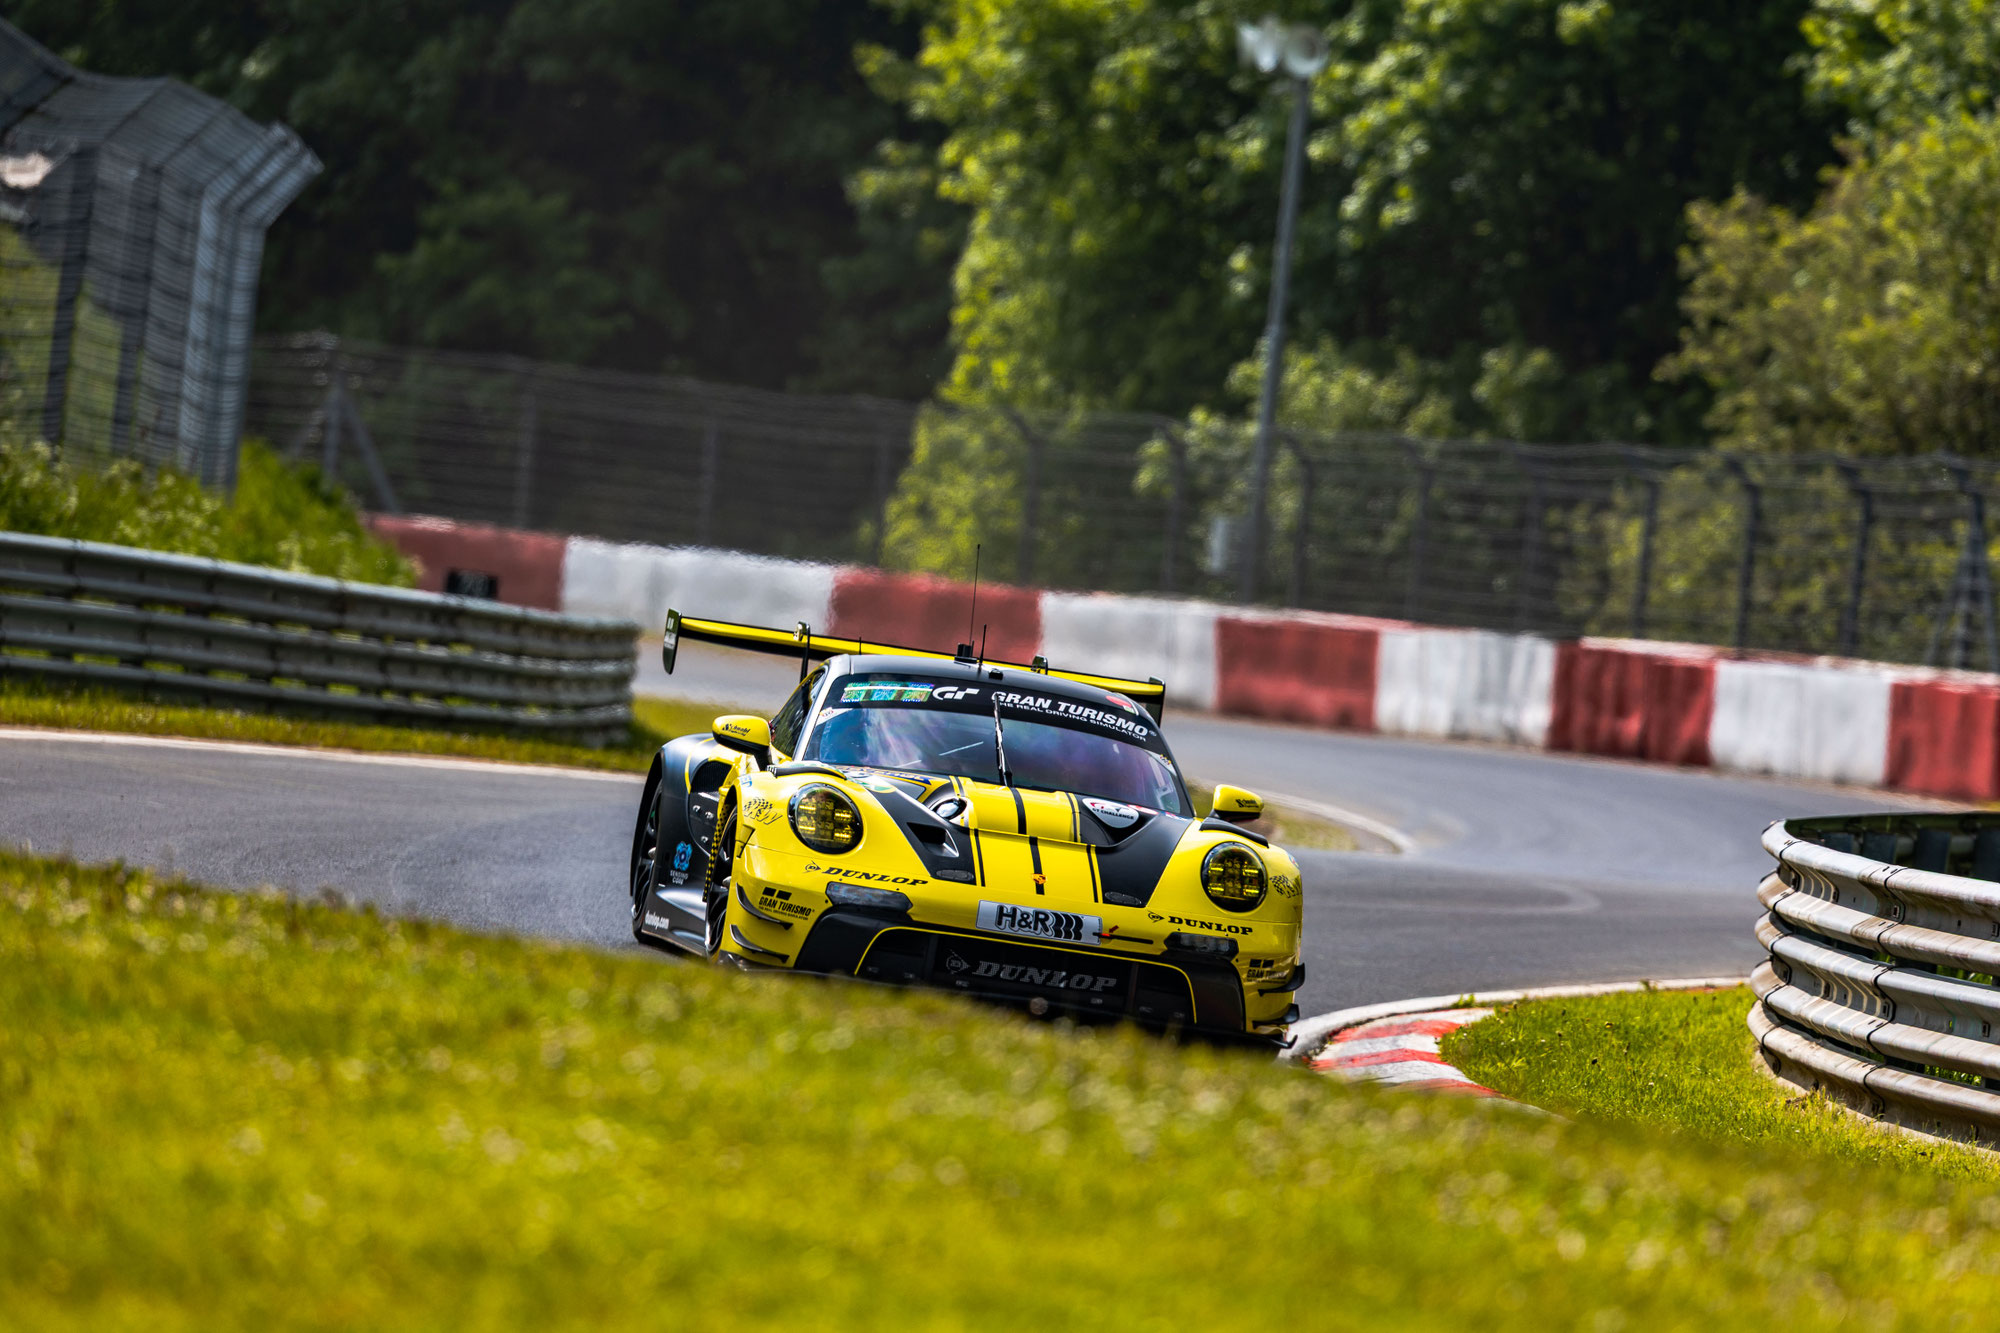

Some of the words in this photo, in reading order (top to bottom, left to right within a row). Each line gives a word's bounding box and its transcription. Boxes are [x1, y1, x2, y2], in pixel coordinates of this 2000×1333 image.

[991, 691, 1051, 709] GRAN
[1057, 701, 1148, 737] TURISMO
[1016, 704, 1044, 713] REAL
[1045, 709, 1088, 722] DRIVING
[1089, 719, 1147, 742] SIMULATOR
[1100, 810, 1134, 819] CHALLENGE
[822, 866, 928, 886] DUNLOP
[758, 896, 778, 908] GRAN
[778, 901, 812, 916] TURISMO
[997, 905, 1050, 933] H&R
[1168, 915, 1253, 935] DUNLOP
[972, 961, 1117, 992] DUNLOP
